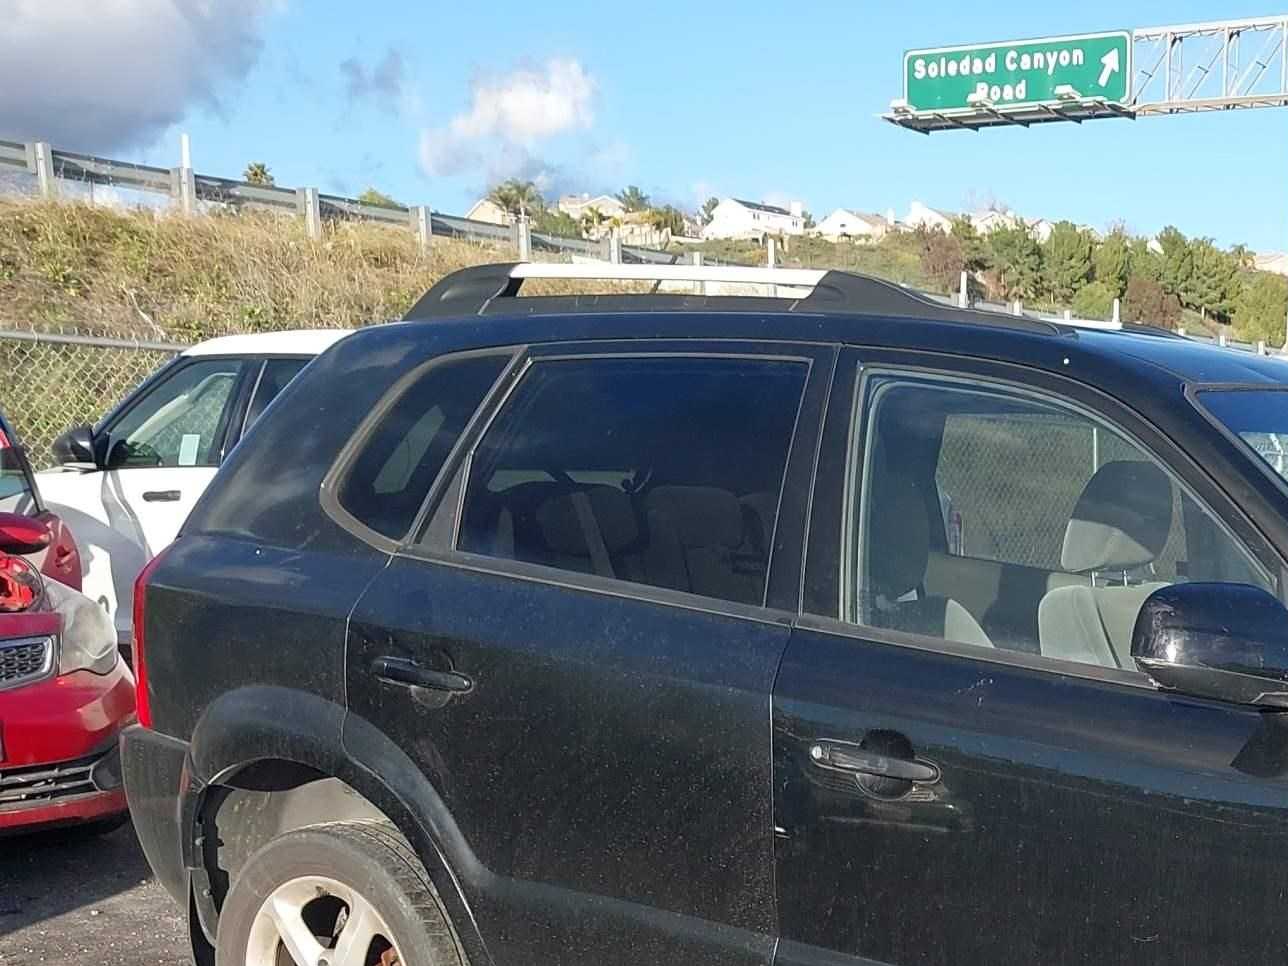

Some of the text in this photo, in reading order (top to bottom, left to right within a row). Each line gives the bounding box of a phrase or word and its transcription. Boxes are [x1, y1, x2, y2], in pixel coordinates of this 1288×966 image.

[913, 48, 1084, 80] Soledad Canyon
[976, 79, 1026, 101] Road
